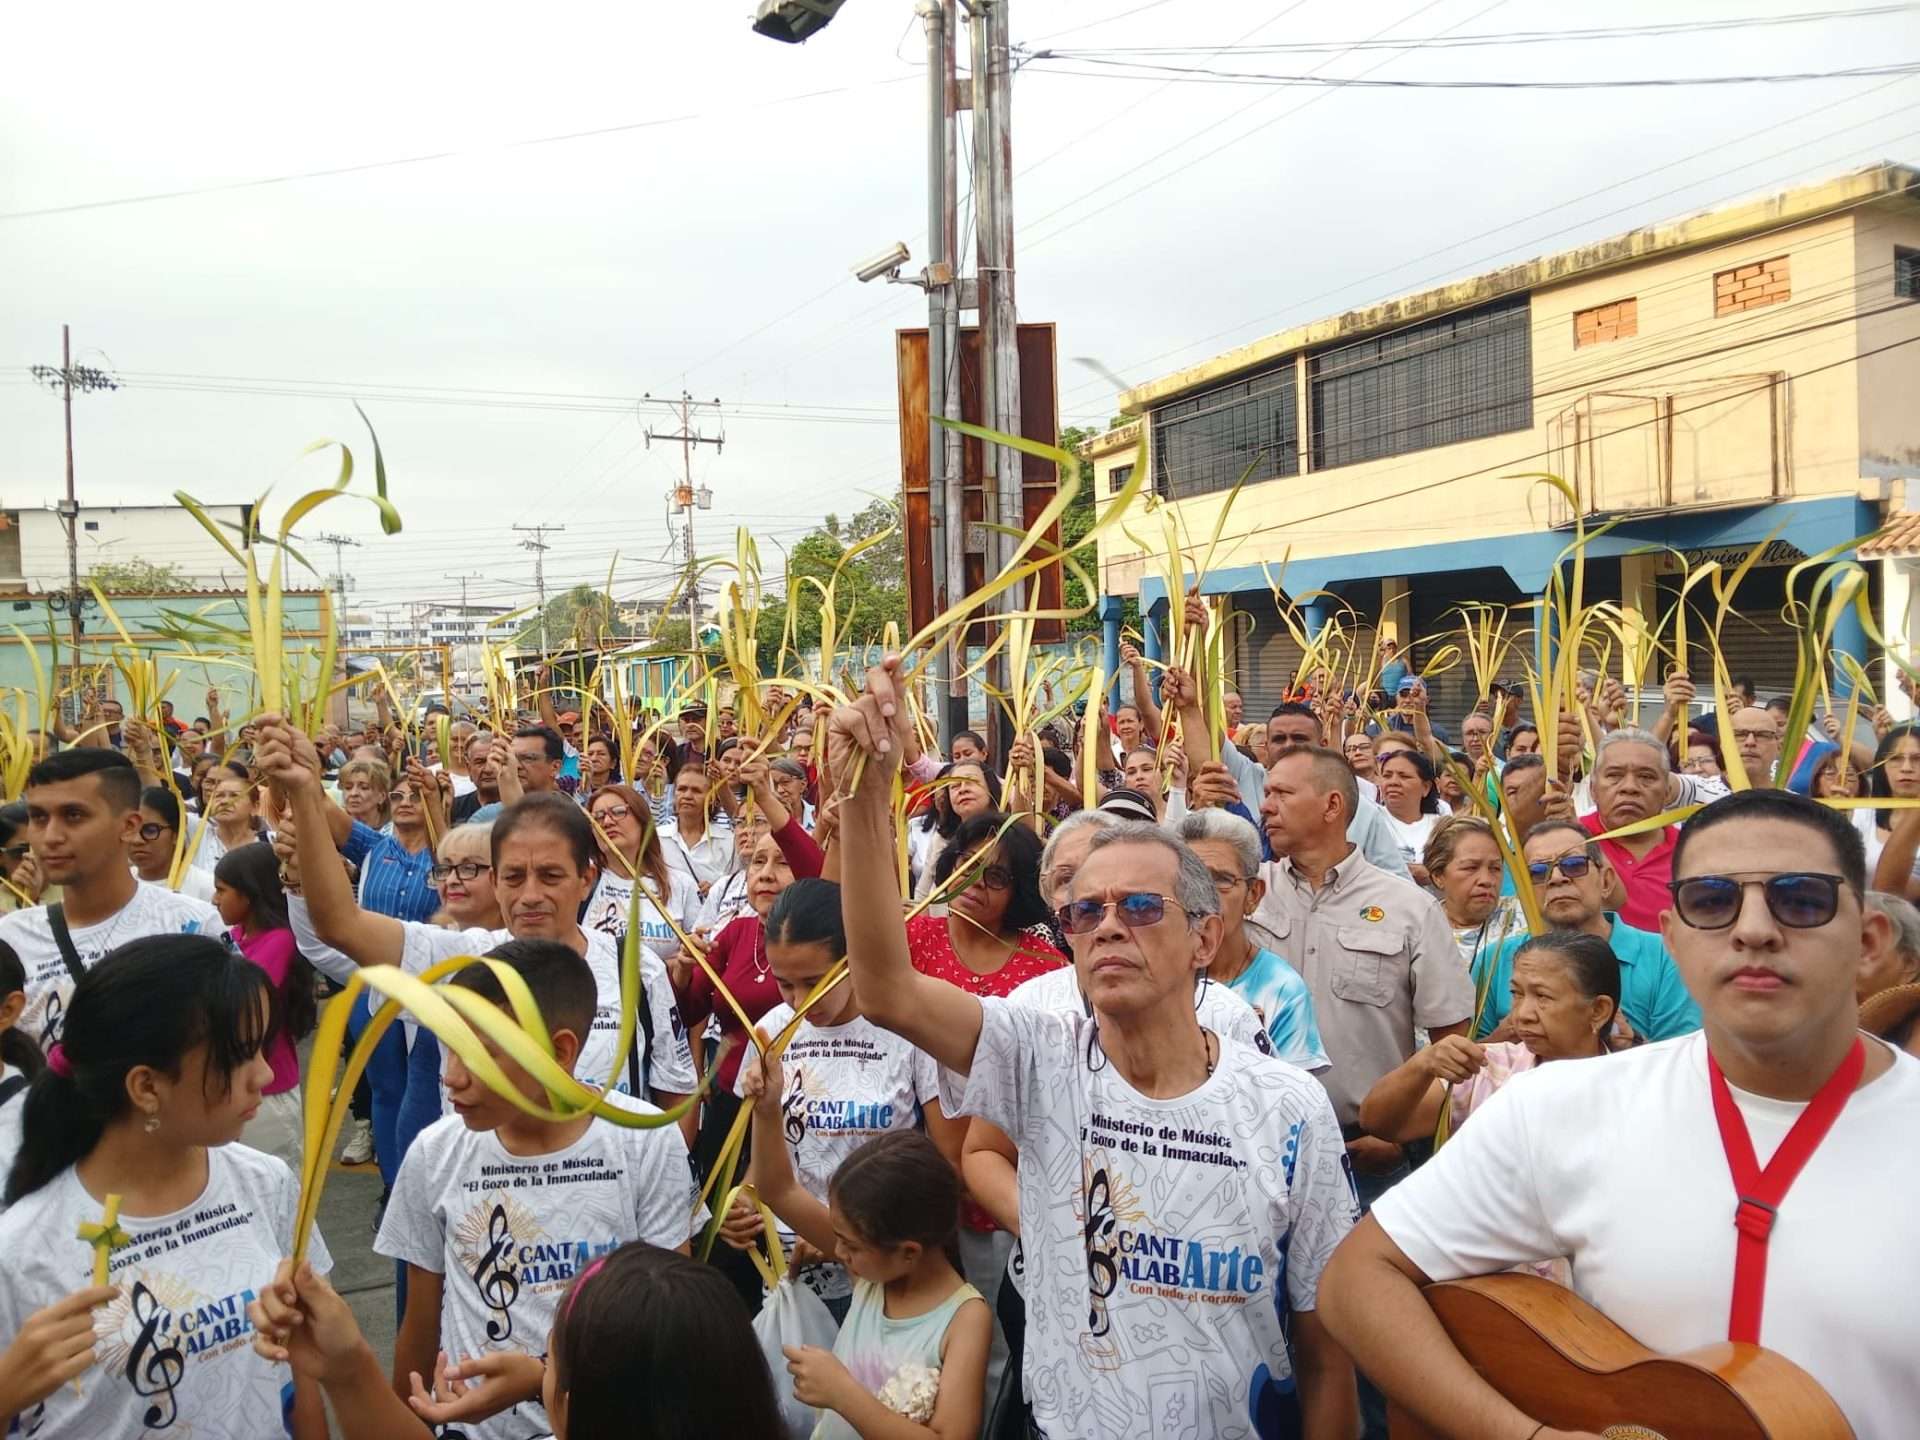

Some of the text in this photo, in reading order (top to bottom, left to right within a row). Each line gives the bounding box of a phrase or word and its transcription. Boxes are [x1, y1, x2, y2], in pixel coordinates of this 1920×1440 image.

[809, 1049, 820, 1058] de
[822, 1049, 831, 1058] la
[831, 1039, 842, 1048] de
[806, 1100, 845, 1114] CANT
[842, 1100, 893, 1129] Arte
[806, 1115, 843, 1129] ALAB
[1159, 1126, 1177, 1141] de
[1121, 1138, 1138, 1153] de
[1143, 1141, 1157, 1157] la
[481, 1156, 604, 1178] Ministerio de Música
[482, 1178, 510, 1191] Gozo
[513, 1176, 527, 1188] de
[531, 1175, 543, 1187] la
[175, 1217, 192, 1233] de
[145, 1244, 163, 1259] de
[165, 1237, 180, 1252] la
[518, 1241, 574, 1264] CANT
[1118, 1230, 1183, 1261] CANT
[519, 1263, 574, 1285] ALAB
[1119, 1256, 1181, 1287] ALAB
[1180, 1240, 1264, 1294] Arte
[1130, 1282, 1153, 1296] Con
[180, 1294, 236, 1334] CANT
[185, 1318, 241, 1355] ALAB
